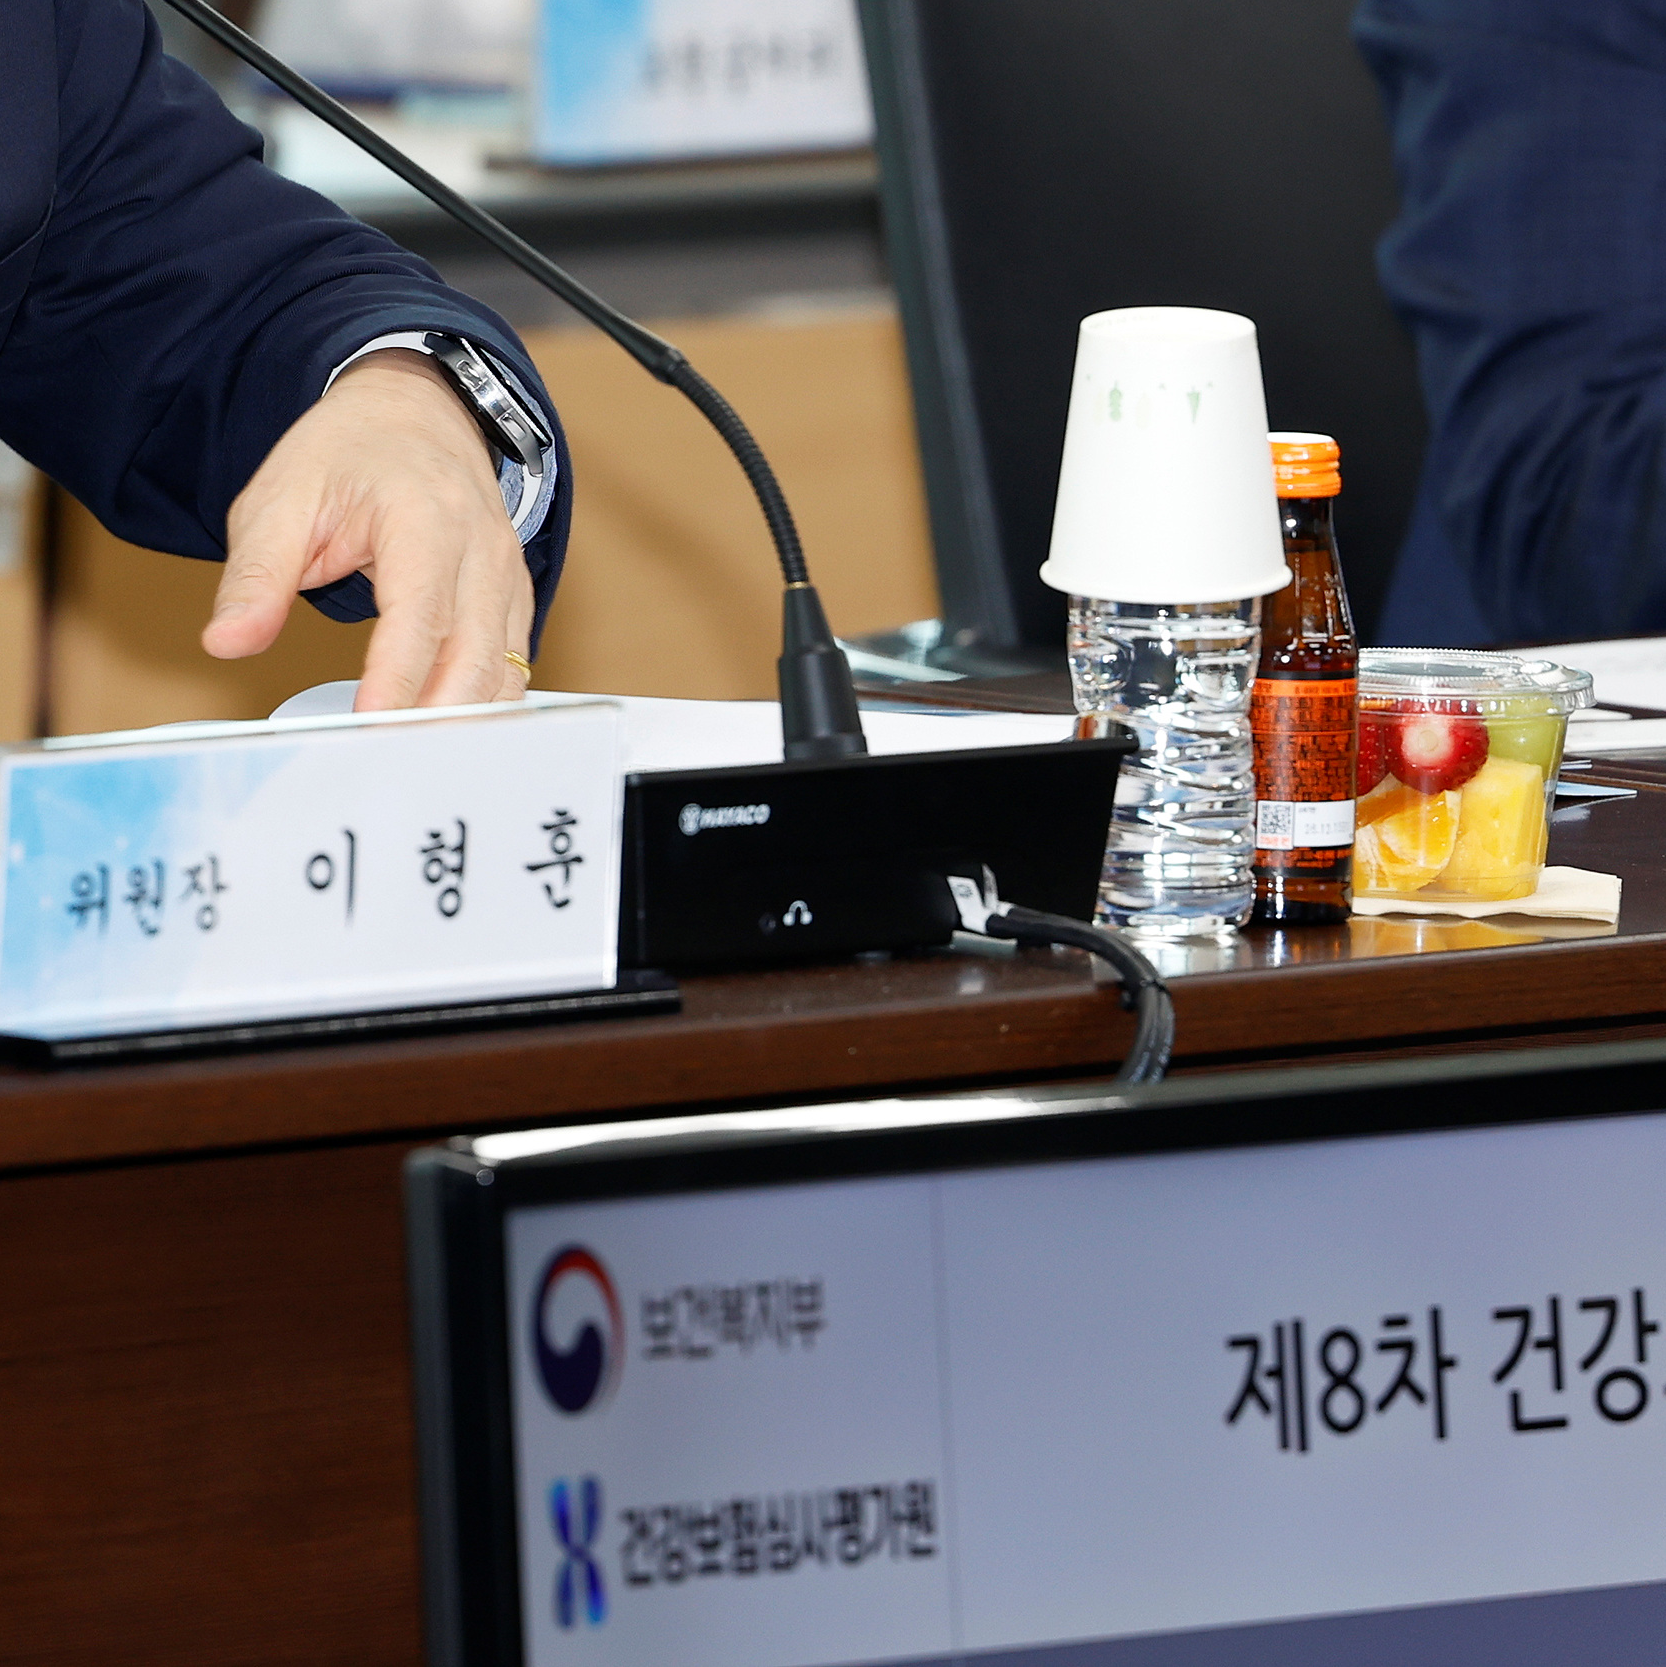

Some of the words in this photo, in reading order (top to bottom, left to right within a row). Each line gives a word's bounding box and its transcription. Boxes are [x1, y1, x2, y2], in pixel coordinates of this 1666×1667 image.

[65, 853, 229, 937] 위원장
[640, 1274, 826, 1361] 보건복지부
[1224, 1304, 1458, 1453] 제8차
[622, 1475, 937, 1589] 건강보험심사평가원
